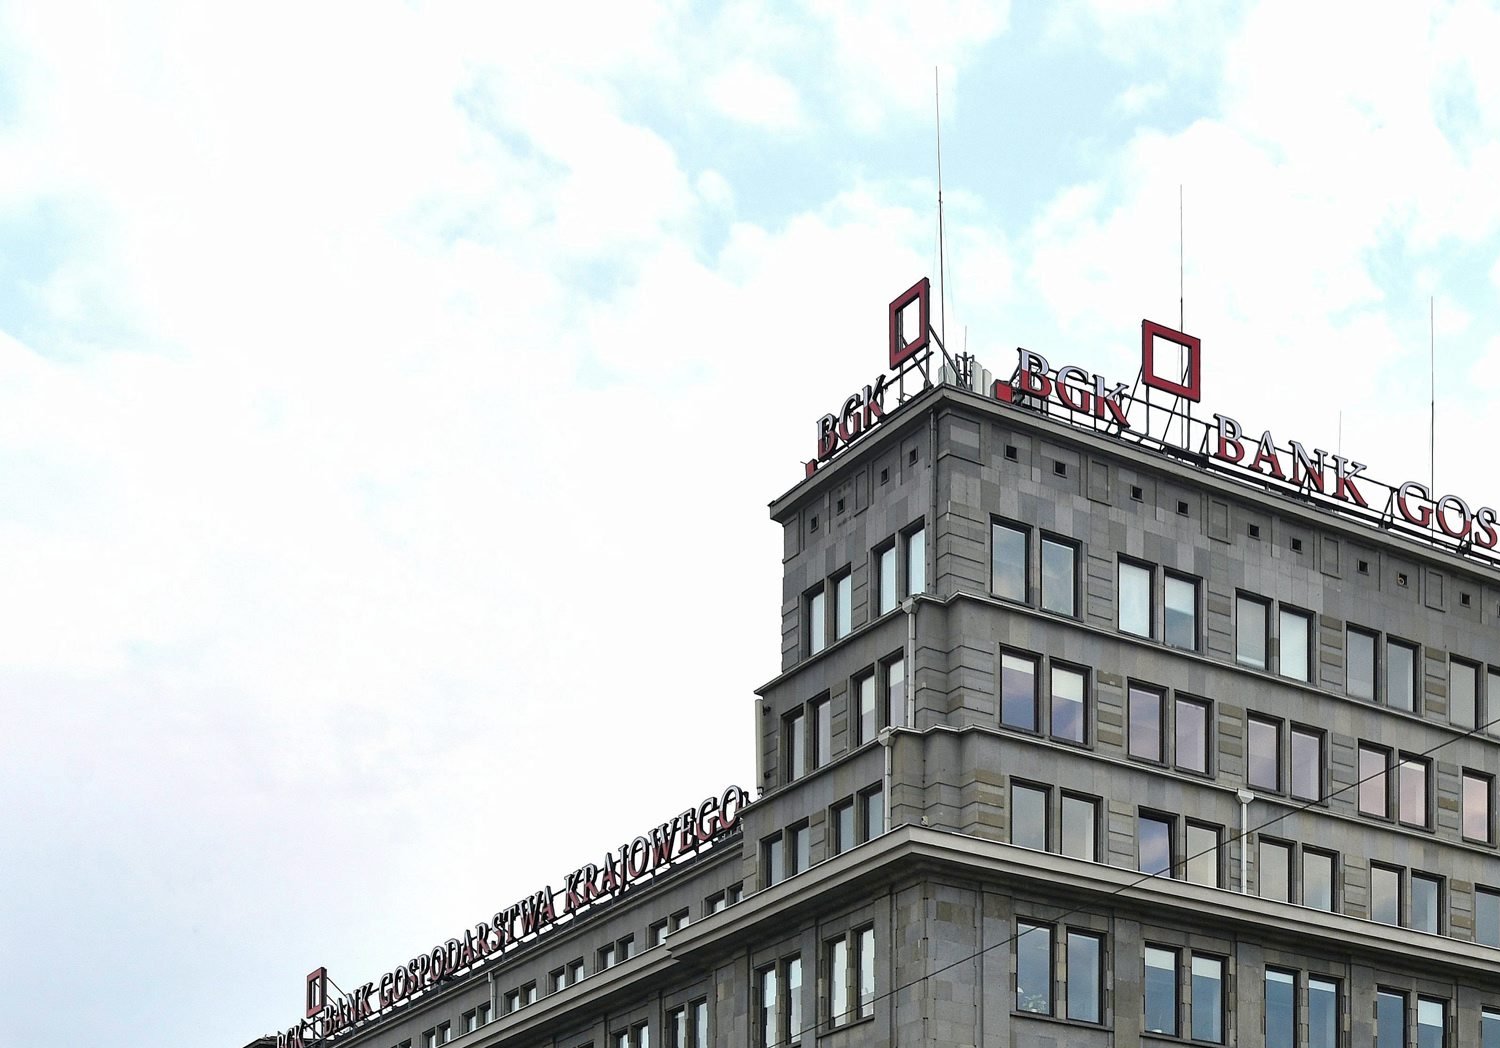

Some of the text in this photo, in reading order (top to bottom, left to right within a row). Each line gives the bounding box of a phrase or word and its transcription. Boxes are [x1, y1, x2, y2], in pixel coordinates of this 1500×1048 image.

[816, 374, 886, 461] BGK
[1017, 347, 1130, 429] BGK
[1213, 413, 1368, 508] BANK
[323, 785, 743, 1037] BANK GOSPODARSTWA KRAJOWEGO
